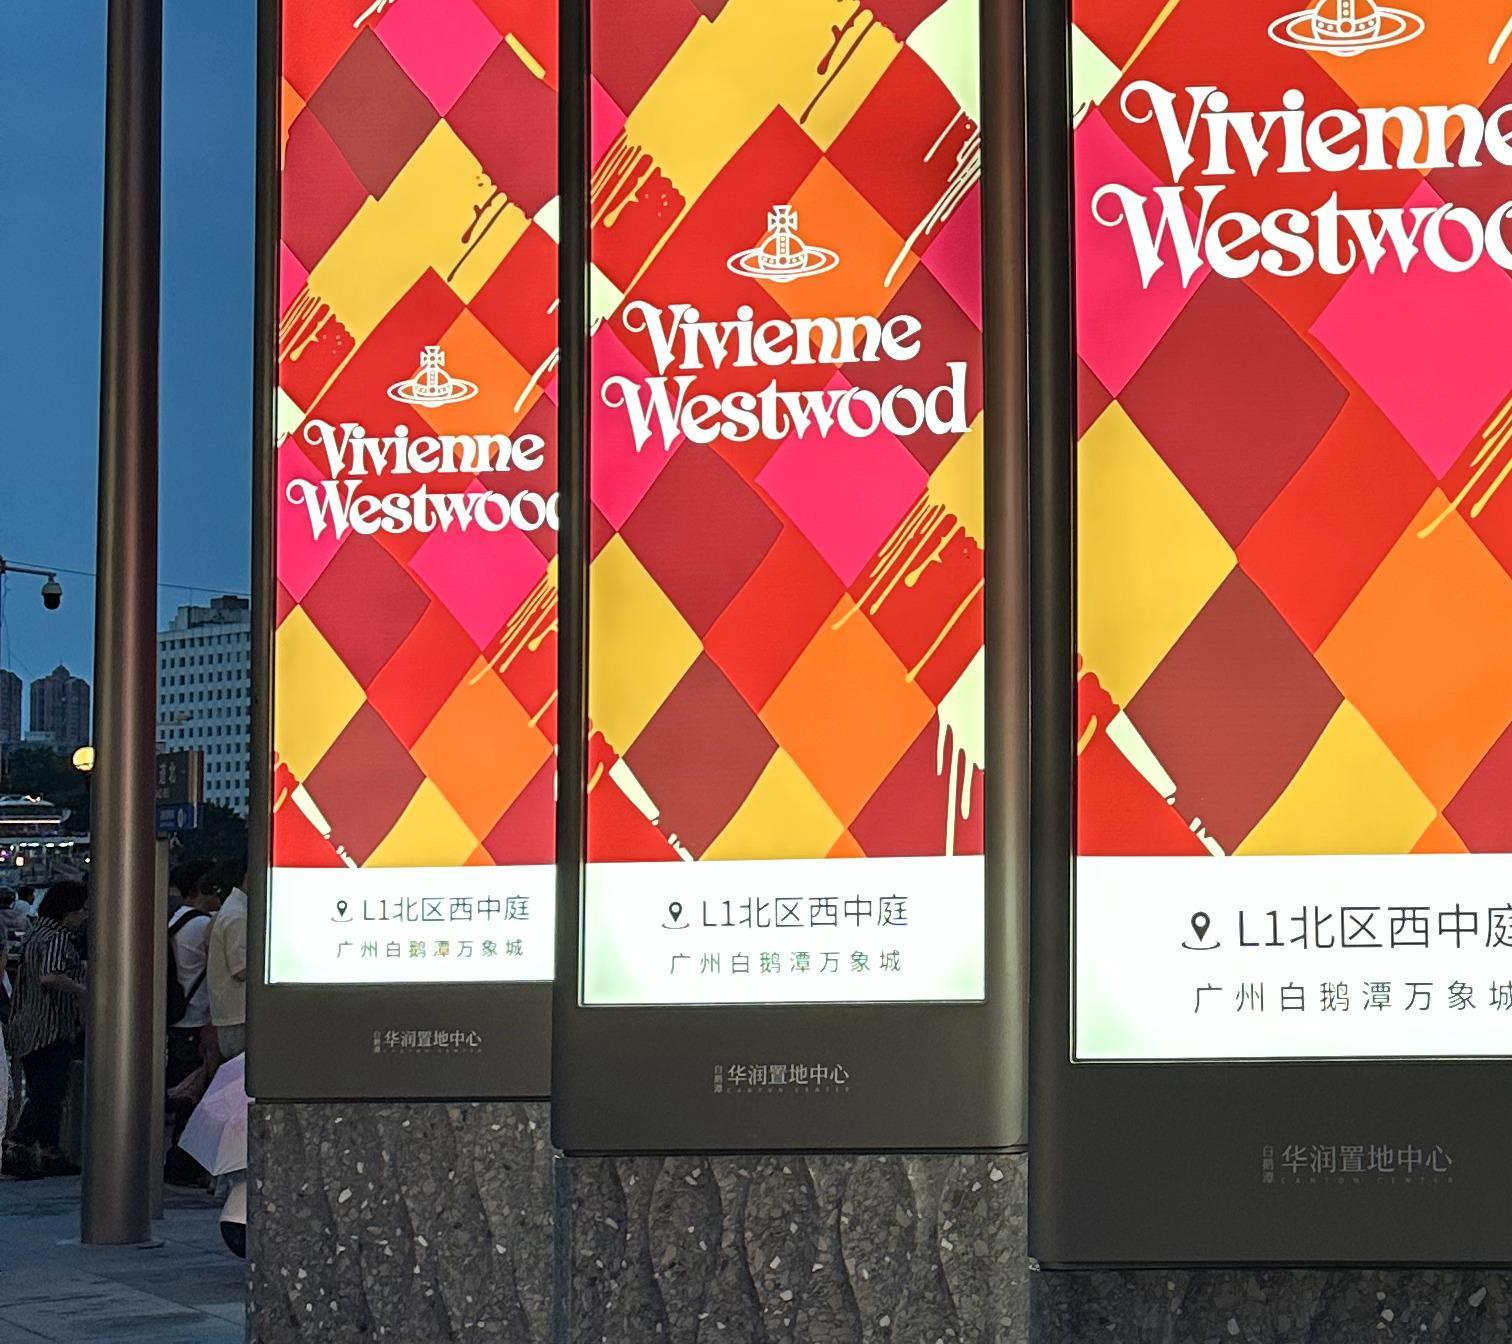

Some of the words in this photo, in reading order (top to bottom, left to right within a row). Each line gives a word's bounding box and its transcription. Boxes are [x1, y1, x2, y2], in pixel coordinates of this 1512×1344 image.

[622, 300, 922, 375] Vivienne
[600, 361, 972, 453] Westwood
[303, 419, 545, 480] Vivienne
[364, 894, 529, 922] L1北区西中庭
[703, 893, 908, 928] L1北区西中庭
[337, 938, 523, 959] 广州白鹅潭万象城
[670, 949, 901, 975] 广州白鹅潭万象城
[384, 1030, 482, 1048] 华润置地中心
[727, 1063, 849, 1086] 华润置地中心
[1282, 1144, 1453, 1174] 华润置地中心
